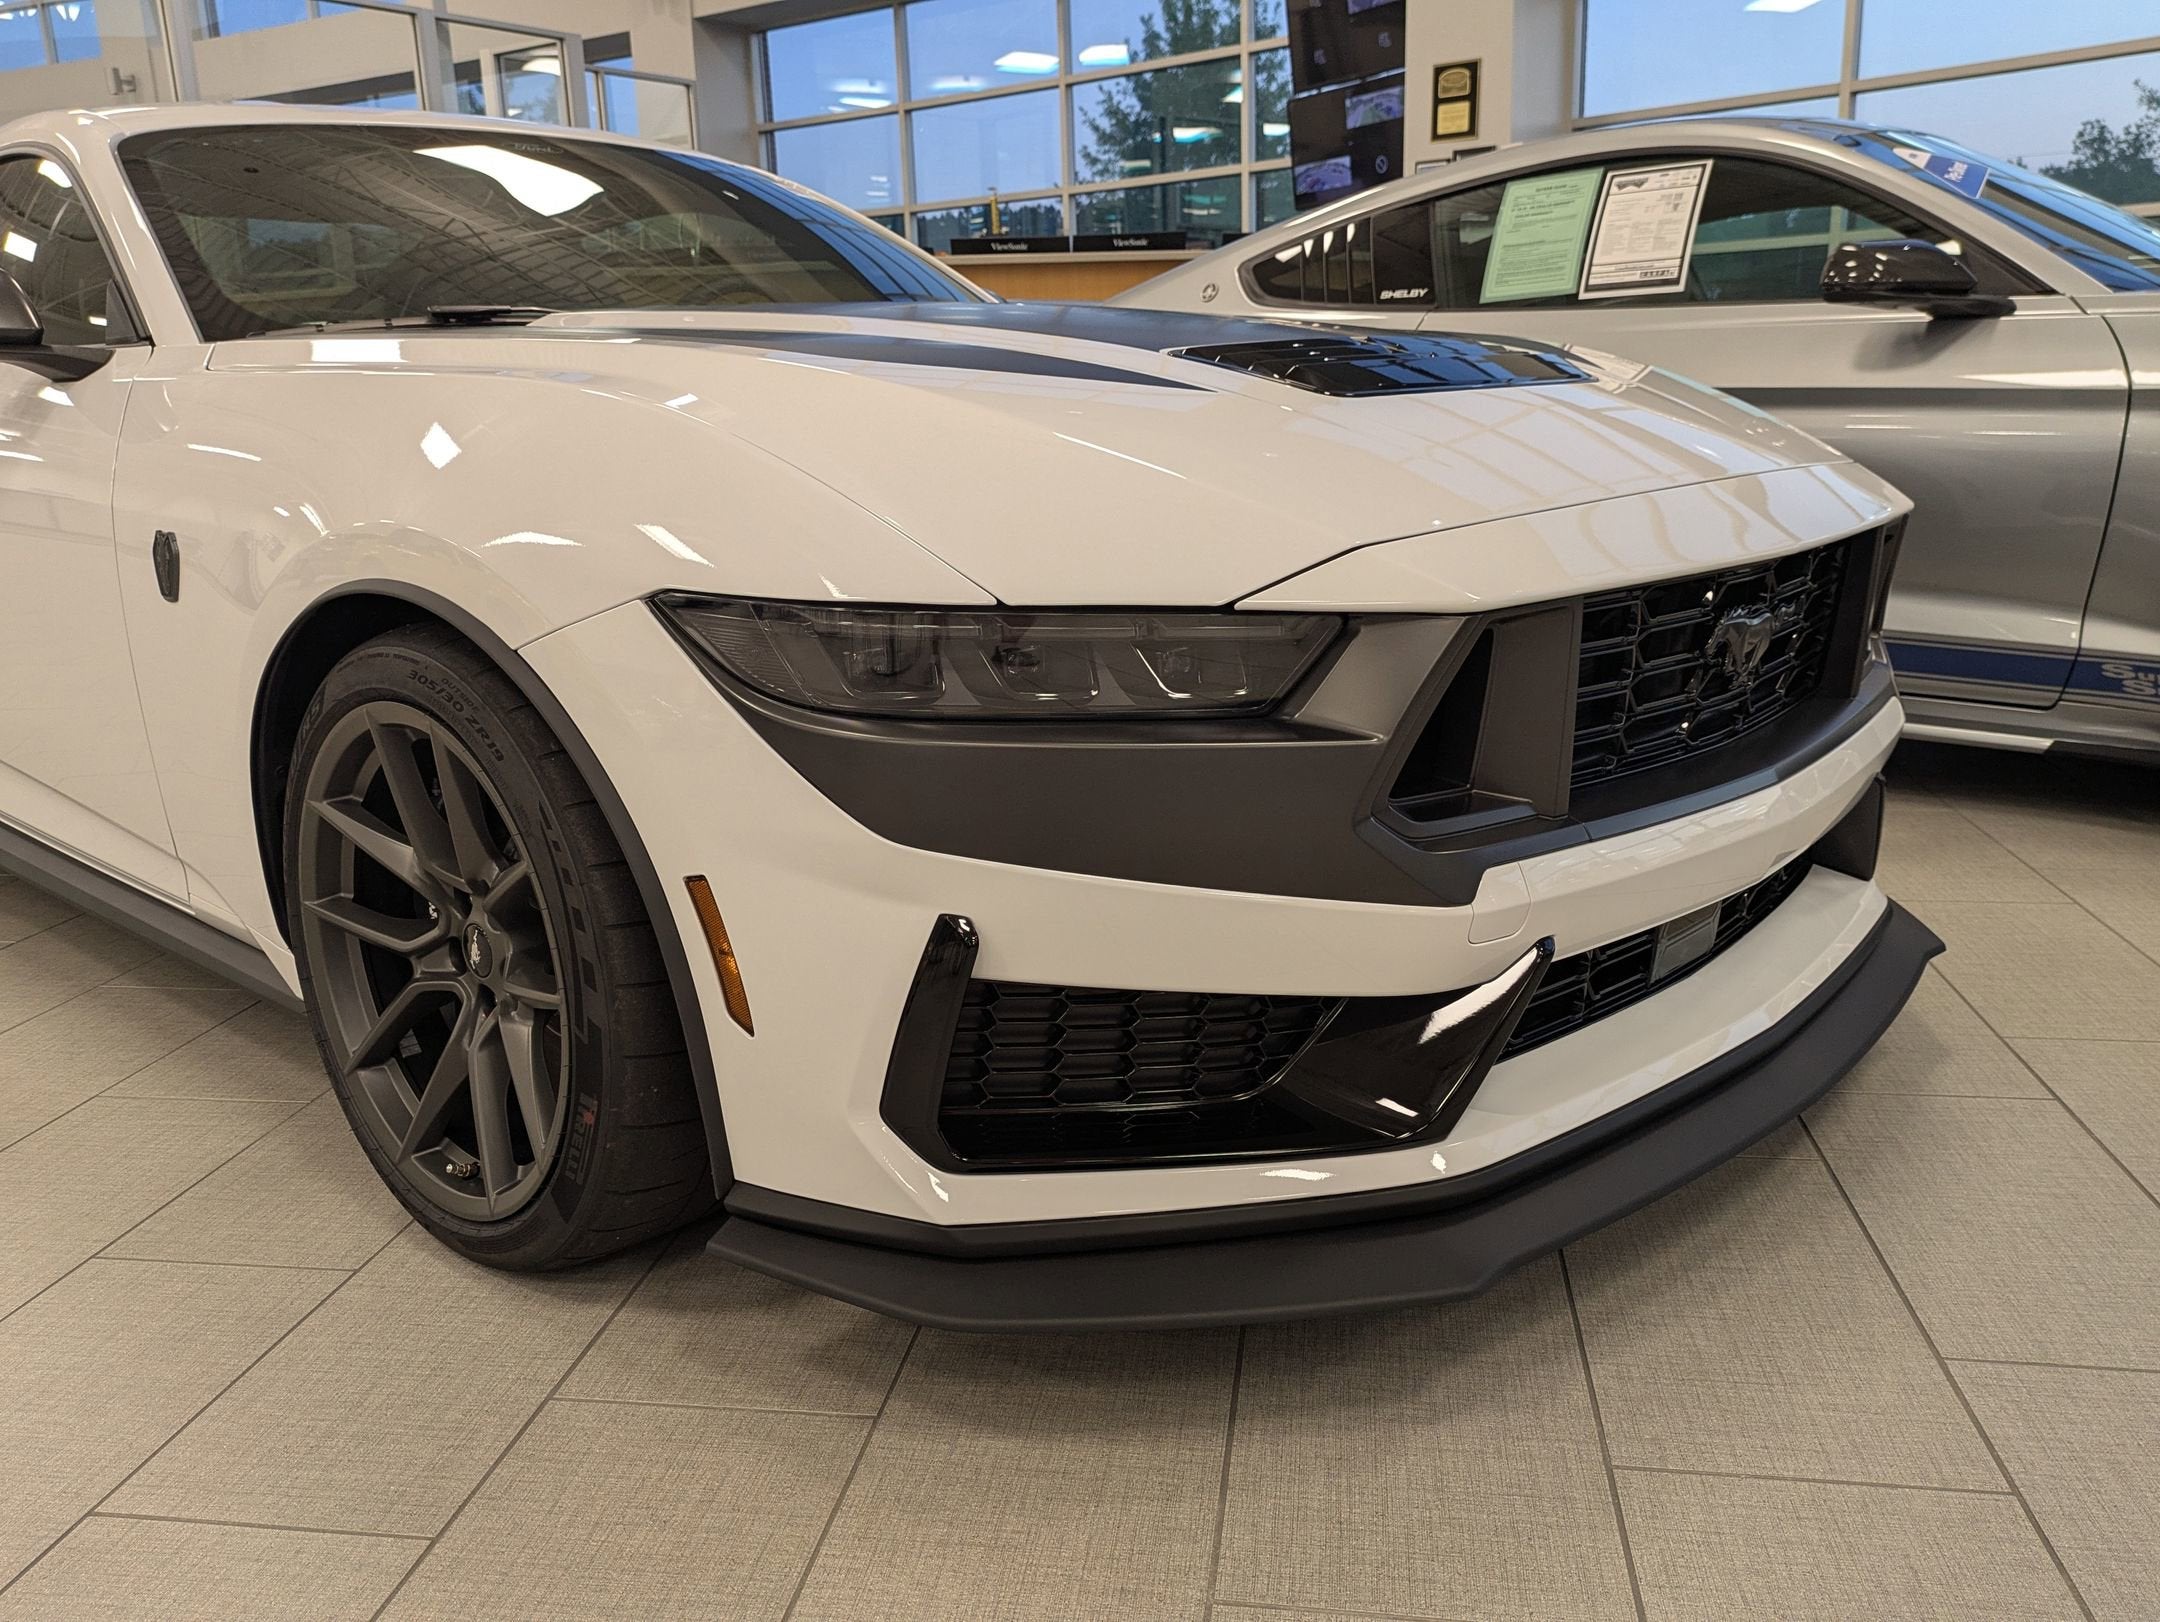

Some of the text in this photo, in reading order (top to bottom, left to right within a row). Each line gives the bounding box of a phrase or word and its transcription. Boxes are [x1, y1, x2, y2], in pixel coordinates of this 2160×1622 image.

[990, 242, 1028, 251] ViewSonic
[1112, 237, 1149, 247] ViewSonic
[1379, 287, 1429, 300] SHELBY
[2101, 663, 2160, 681] Su
[441, 677, 480, 713] OUTSIDE
[406, 669, 466, 713] 305/30
[464, 714, 506, 763] ZR19
[565, 1092, 599, 1185] PIRELLI
